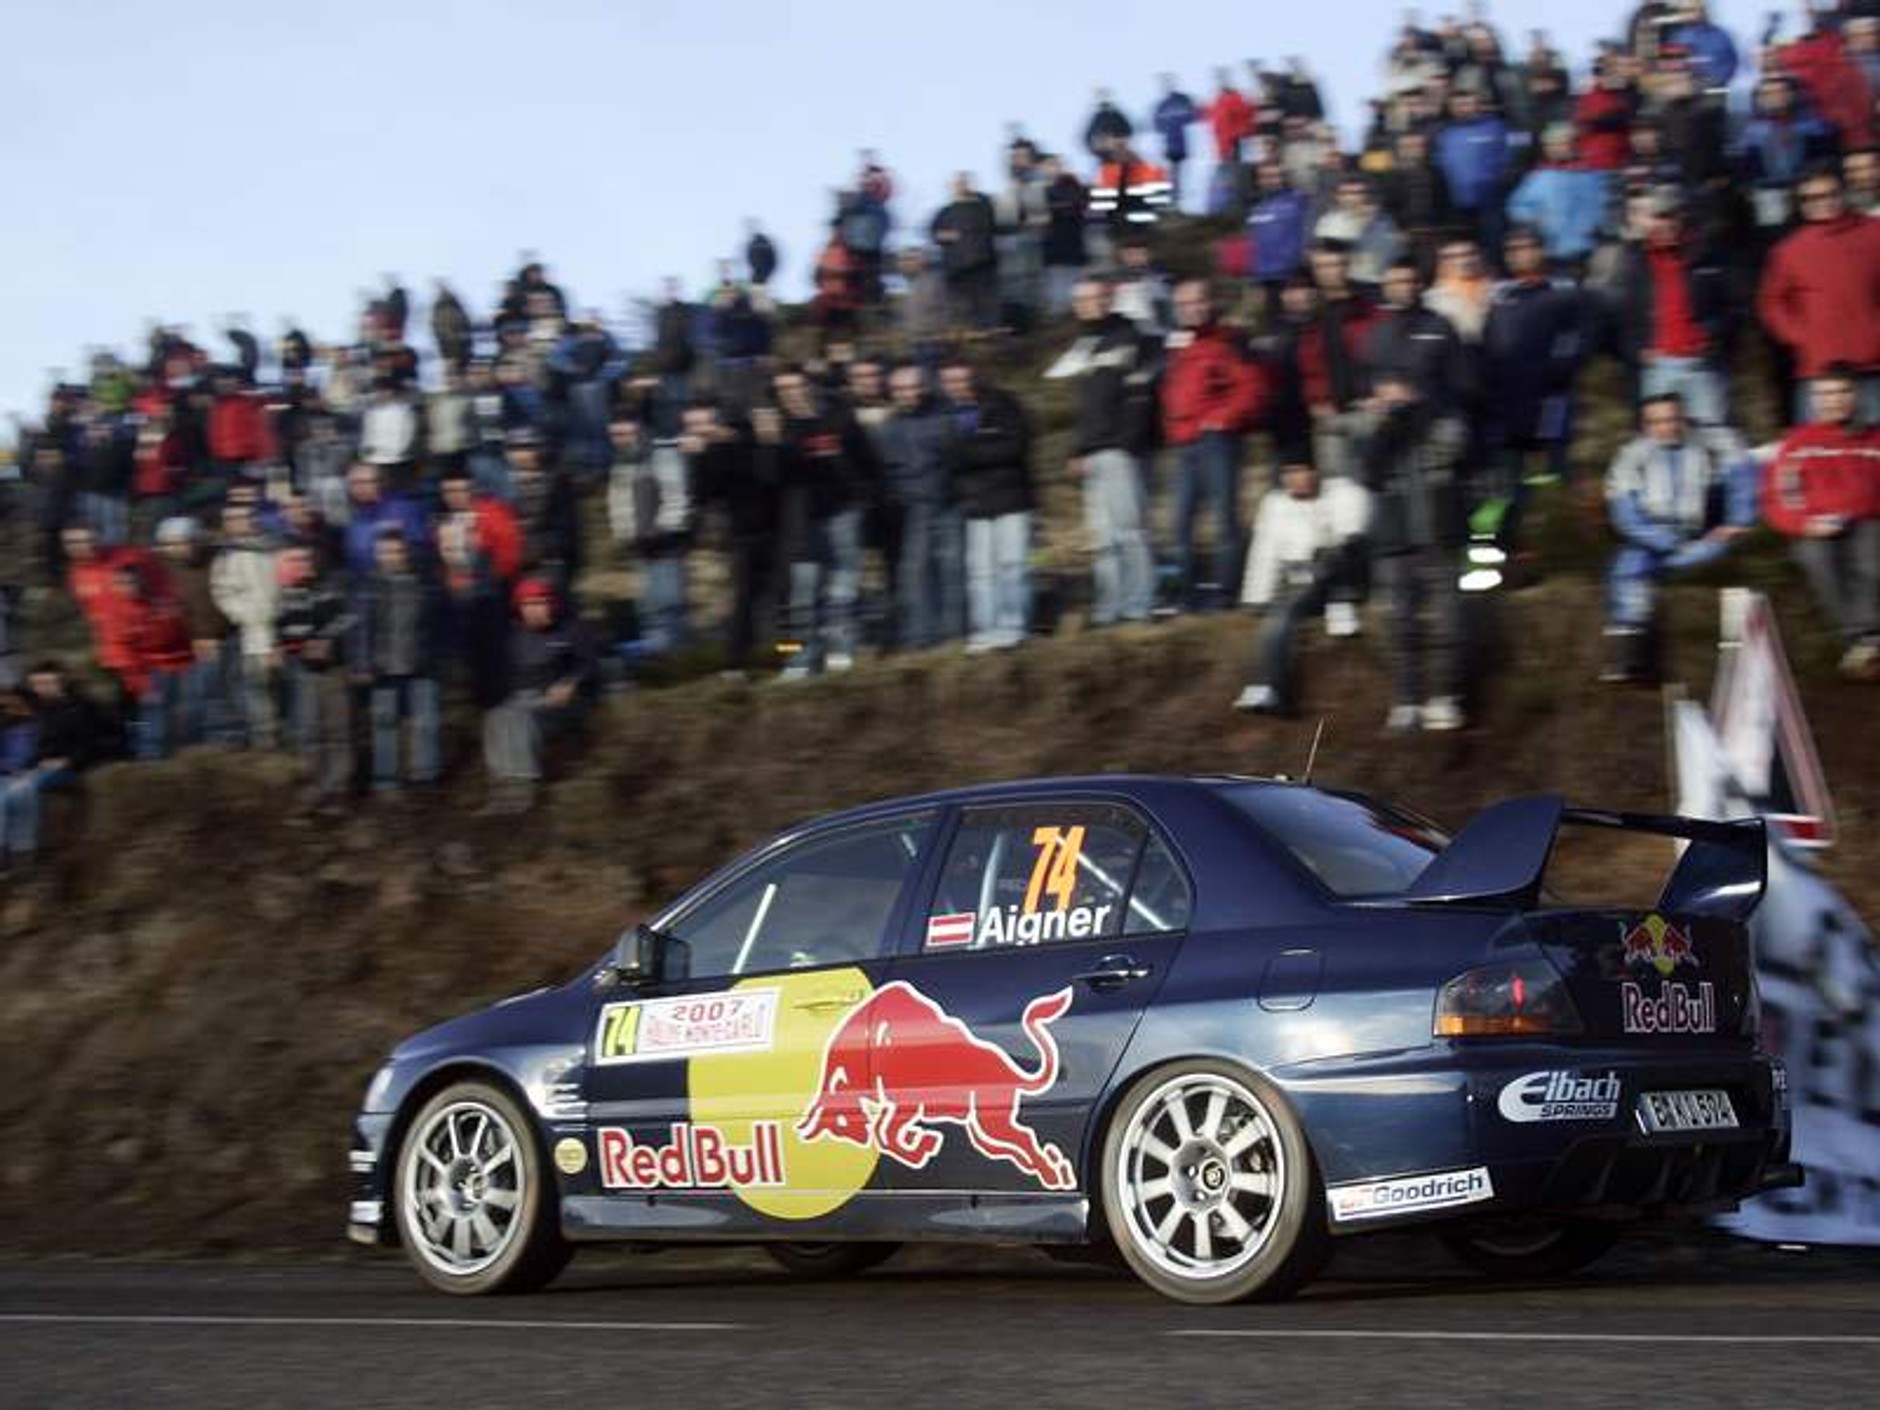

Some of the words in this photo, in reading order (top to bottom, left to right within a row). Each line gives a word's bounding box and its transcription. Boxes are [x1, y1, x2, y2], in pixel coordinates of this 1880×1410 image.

[1023, 826, 1085, 913] 74
[976, 905, 1111, 946] Aigner
[603, 1006, 640, 1058] 74
[672, 1000, 742, 1023] 2007
[1622, 981, 1671, 1032] Red
[1674, 981, 1715, 1032] Bull
[1541, 1105, 1611, 1118] SPRINGS
[599, 1124, 692, 1187] Red
[693, 1122, 785, 1185] Bull
